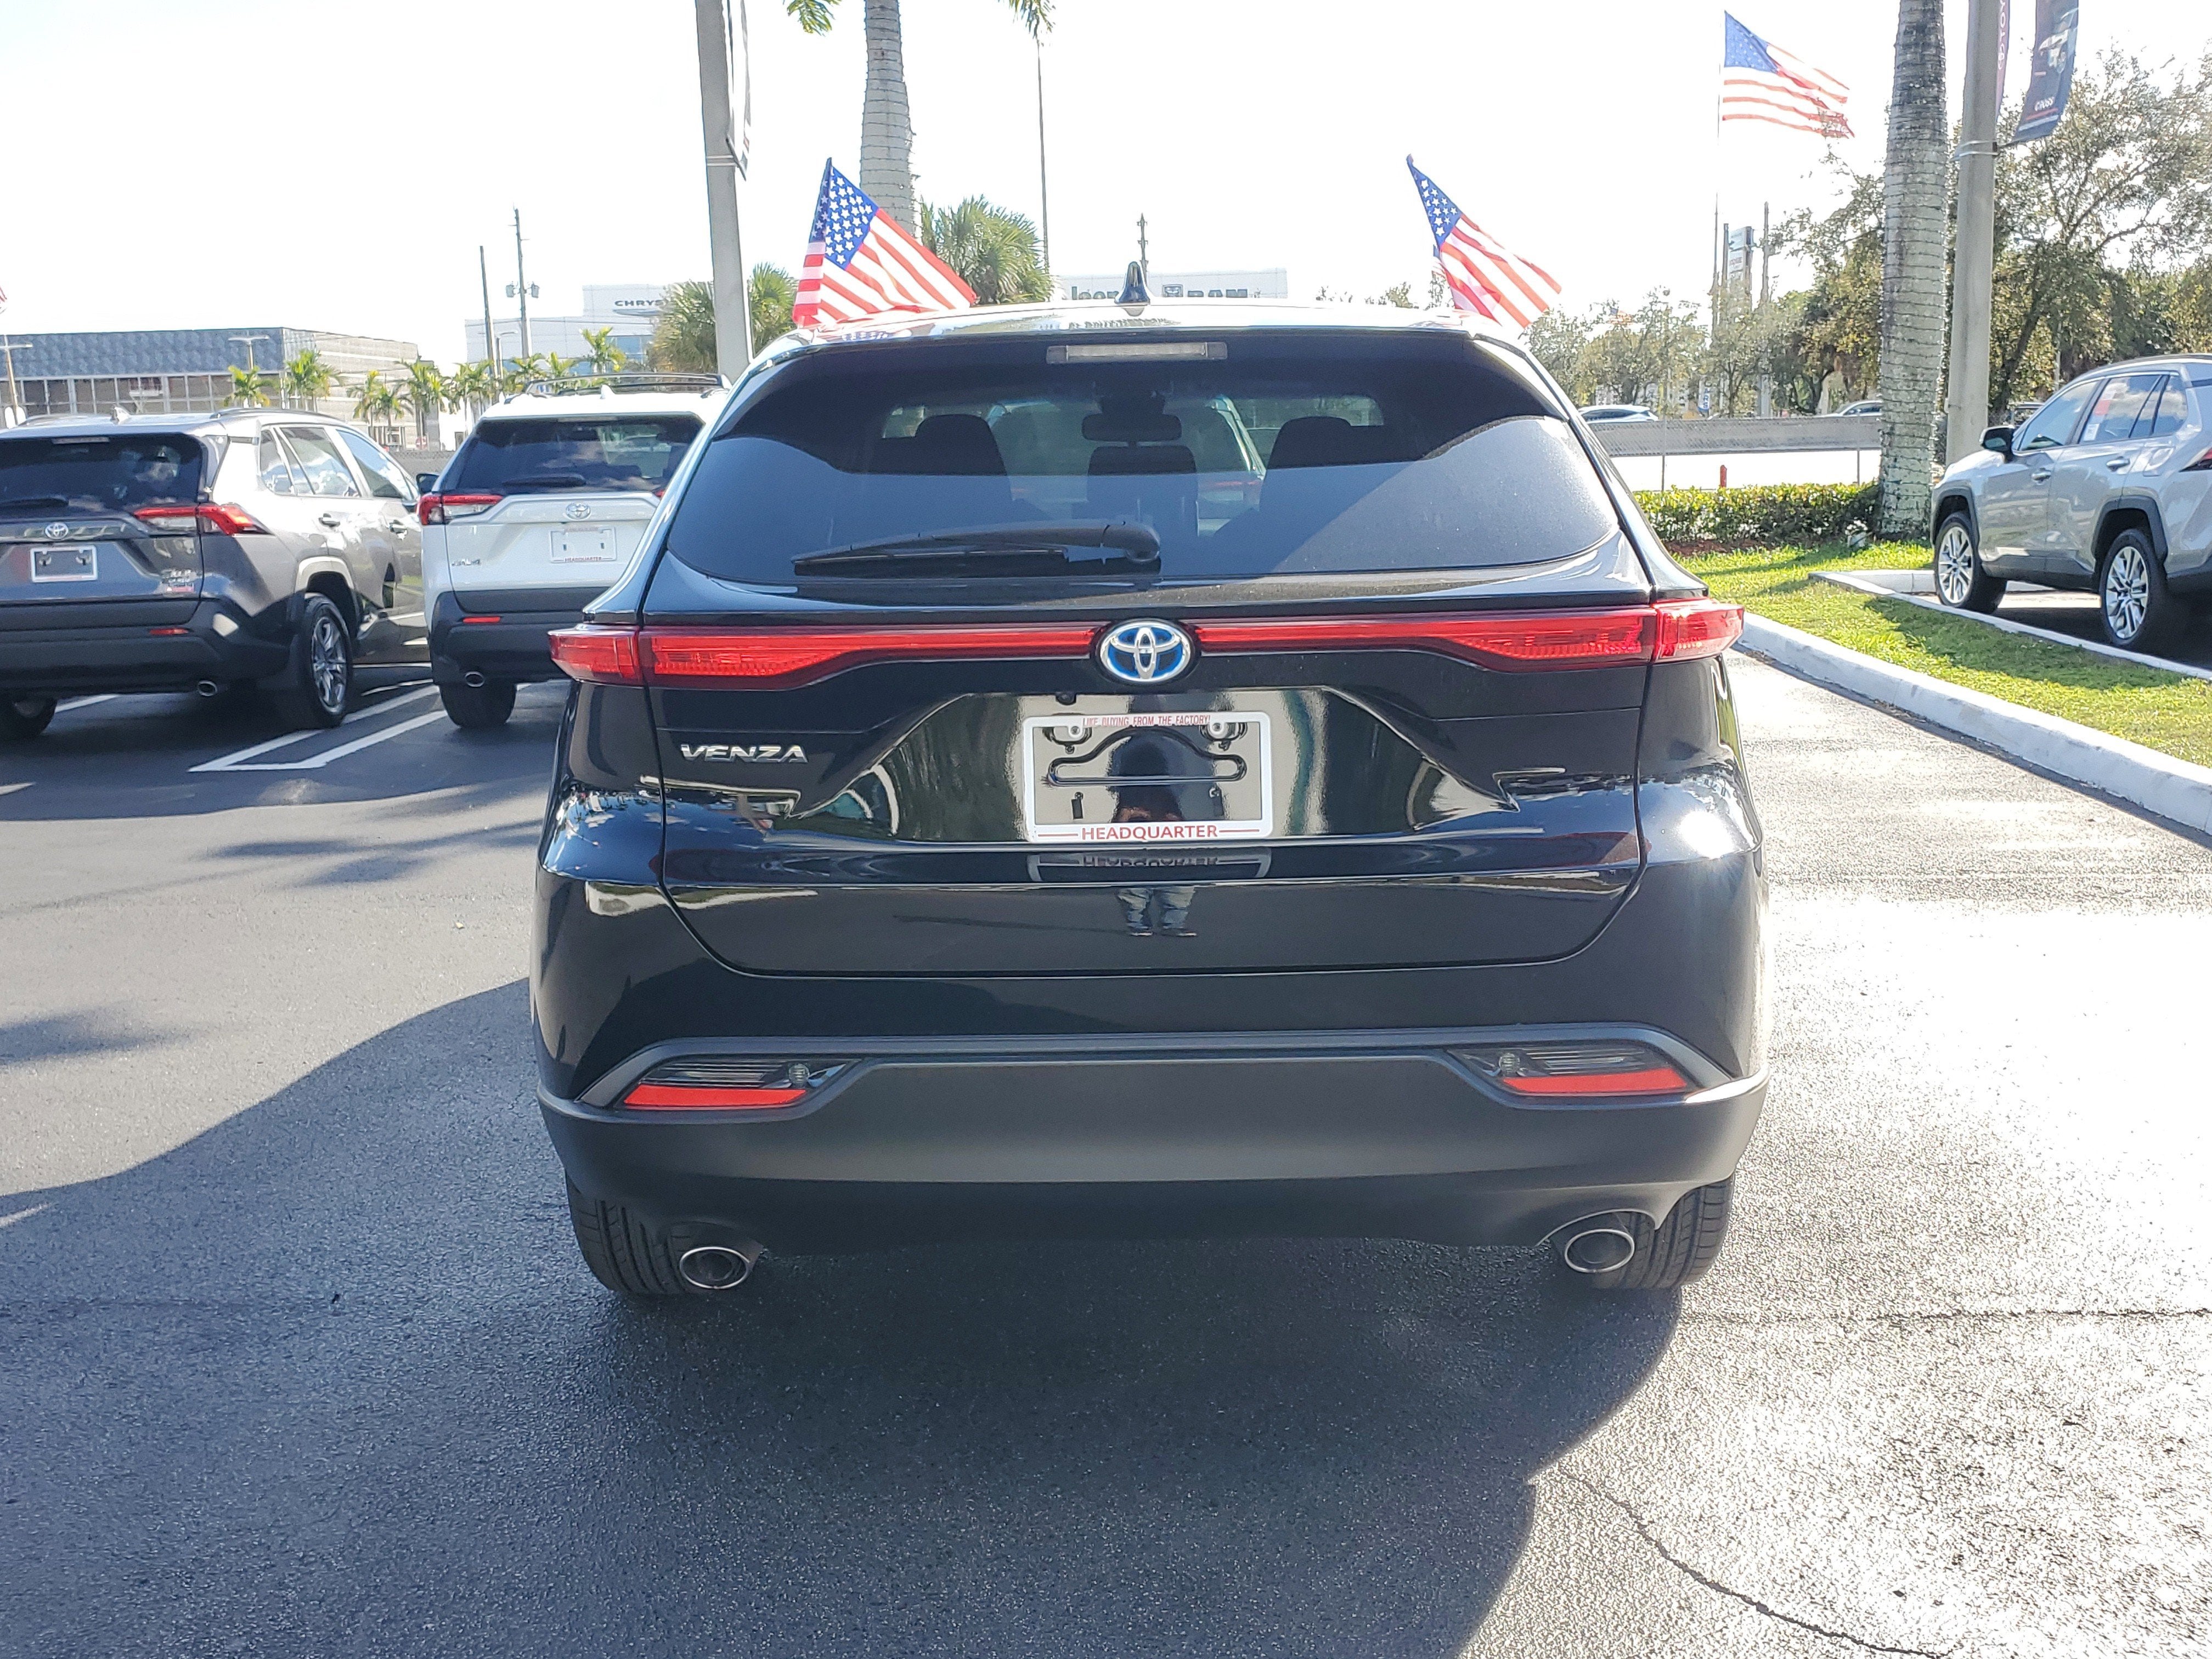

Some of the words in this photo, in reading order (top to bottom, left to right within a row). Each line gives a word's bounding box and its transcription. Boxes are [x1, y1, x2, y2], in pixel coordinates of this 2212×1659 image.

[1133, 716, 1154, 726] FROM
[1158, 715, 1172, 725] THE
[1176, 715, 1211, 725] FACTORY!
[681, 744, 809, 763] VENZA
[1082, 825, 1218, 840] HEADQUARTER
